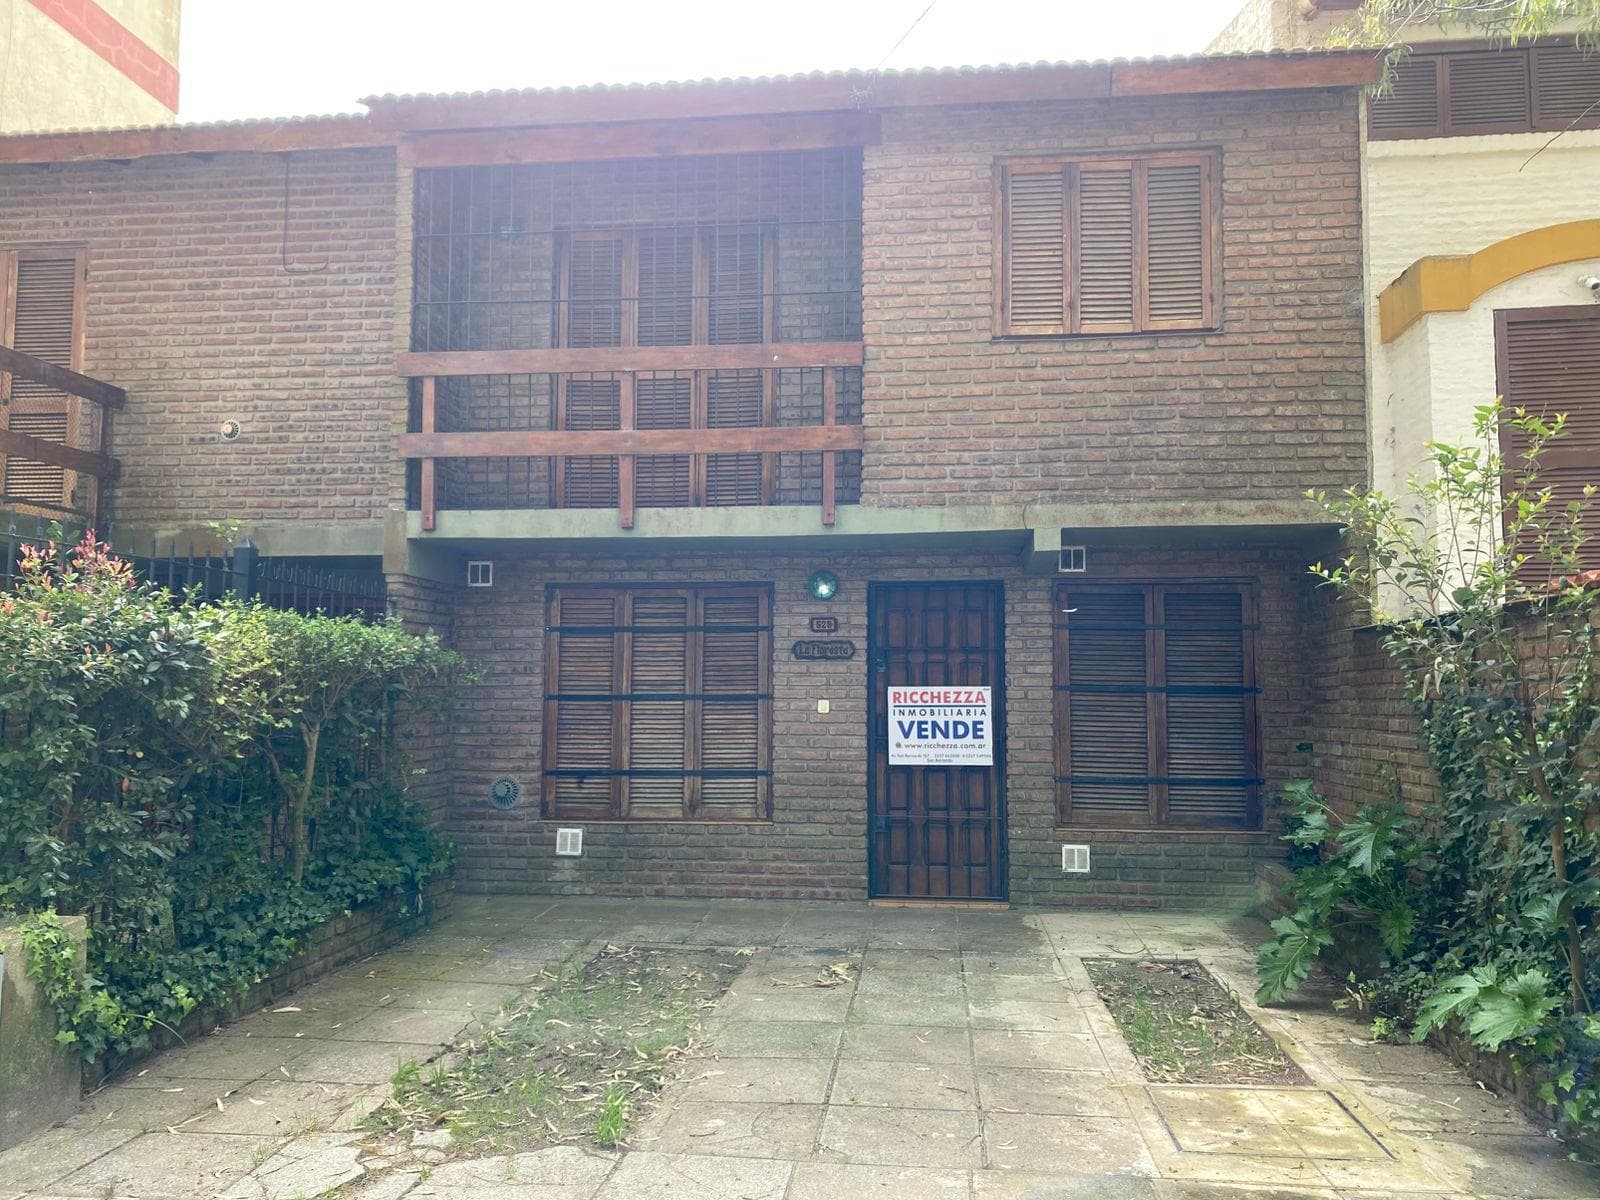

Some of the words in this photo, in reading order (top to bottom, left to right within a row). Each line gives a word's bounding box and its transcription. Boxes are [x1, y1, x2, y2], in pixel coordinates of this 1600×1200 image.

[893, 691, 986, 704] RICCHEZZA
[893, 709, 987, 717] INMOBILIARIA
[897, 720, 985, 740] VENDE
